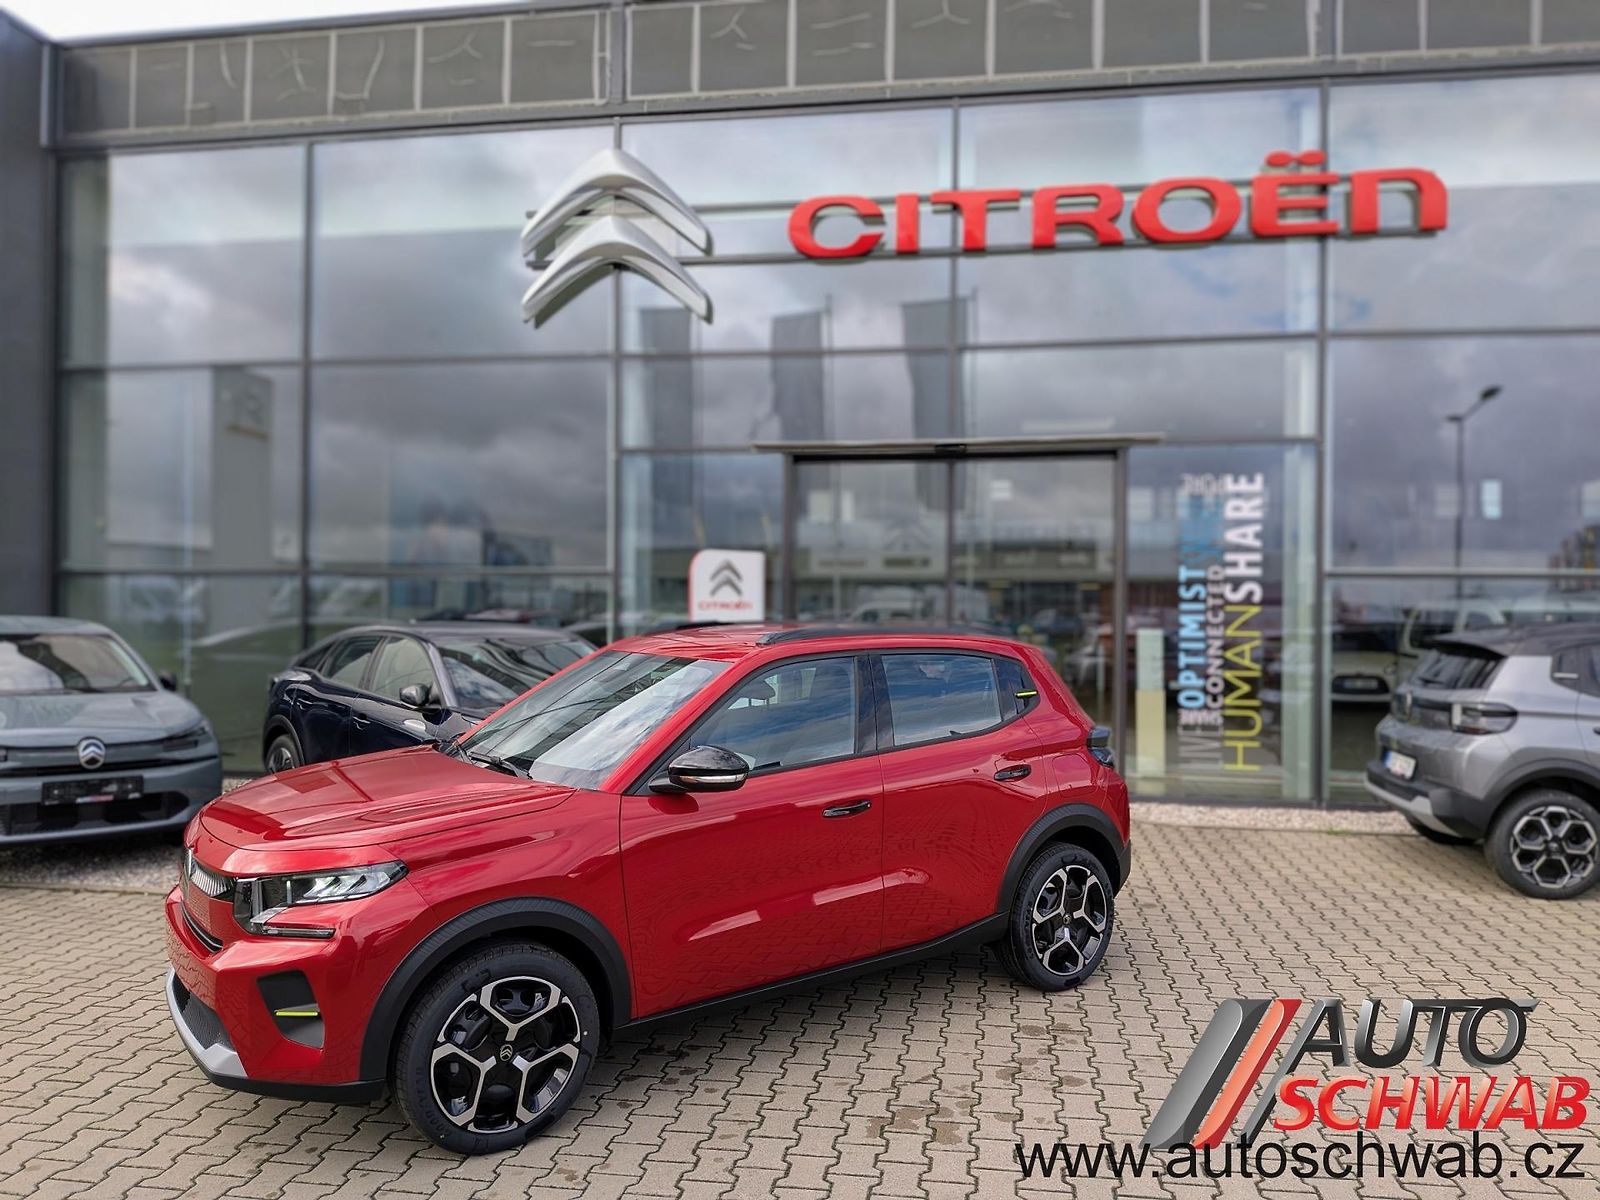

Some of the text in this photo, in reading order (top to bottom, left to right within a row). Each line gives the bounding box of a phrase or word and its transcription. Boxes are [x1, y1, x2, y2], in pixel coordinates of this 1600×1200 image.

[788, 150, 1448, 259] CITROËN
[1223, 473, 1263, 603] SHARE
[1178, 565, 1206, 708] OPTIMIST
[1206, 565, 1224, 708] CONNECTED
[1223, 605, 1262, 771] HUMAN
